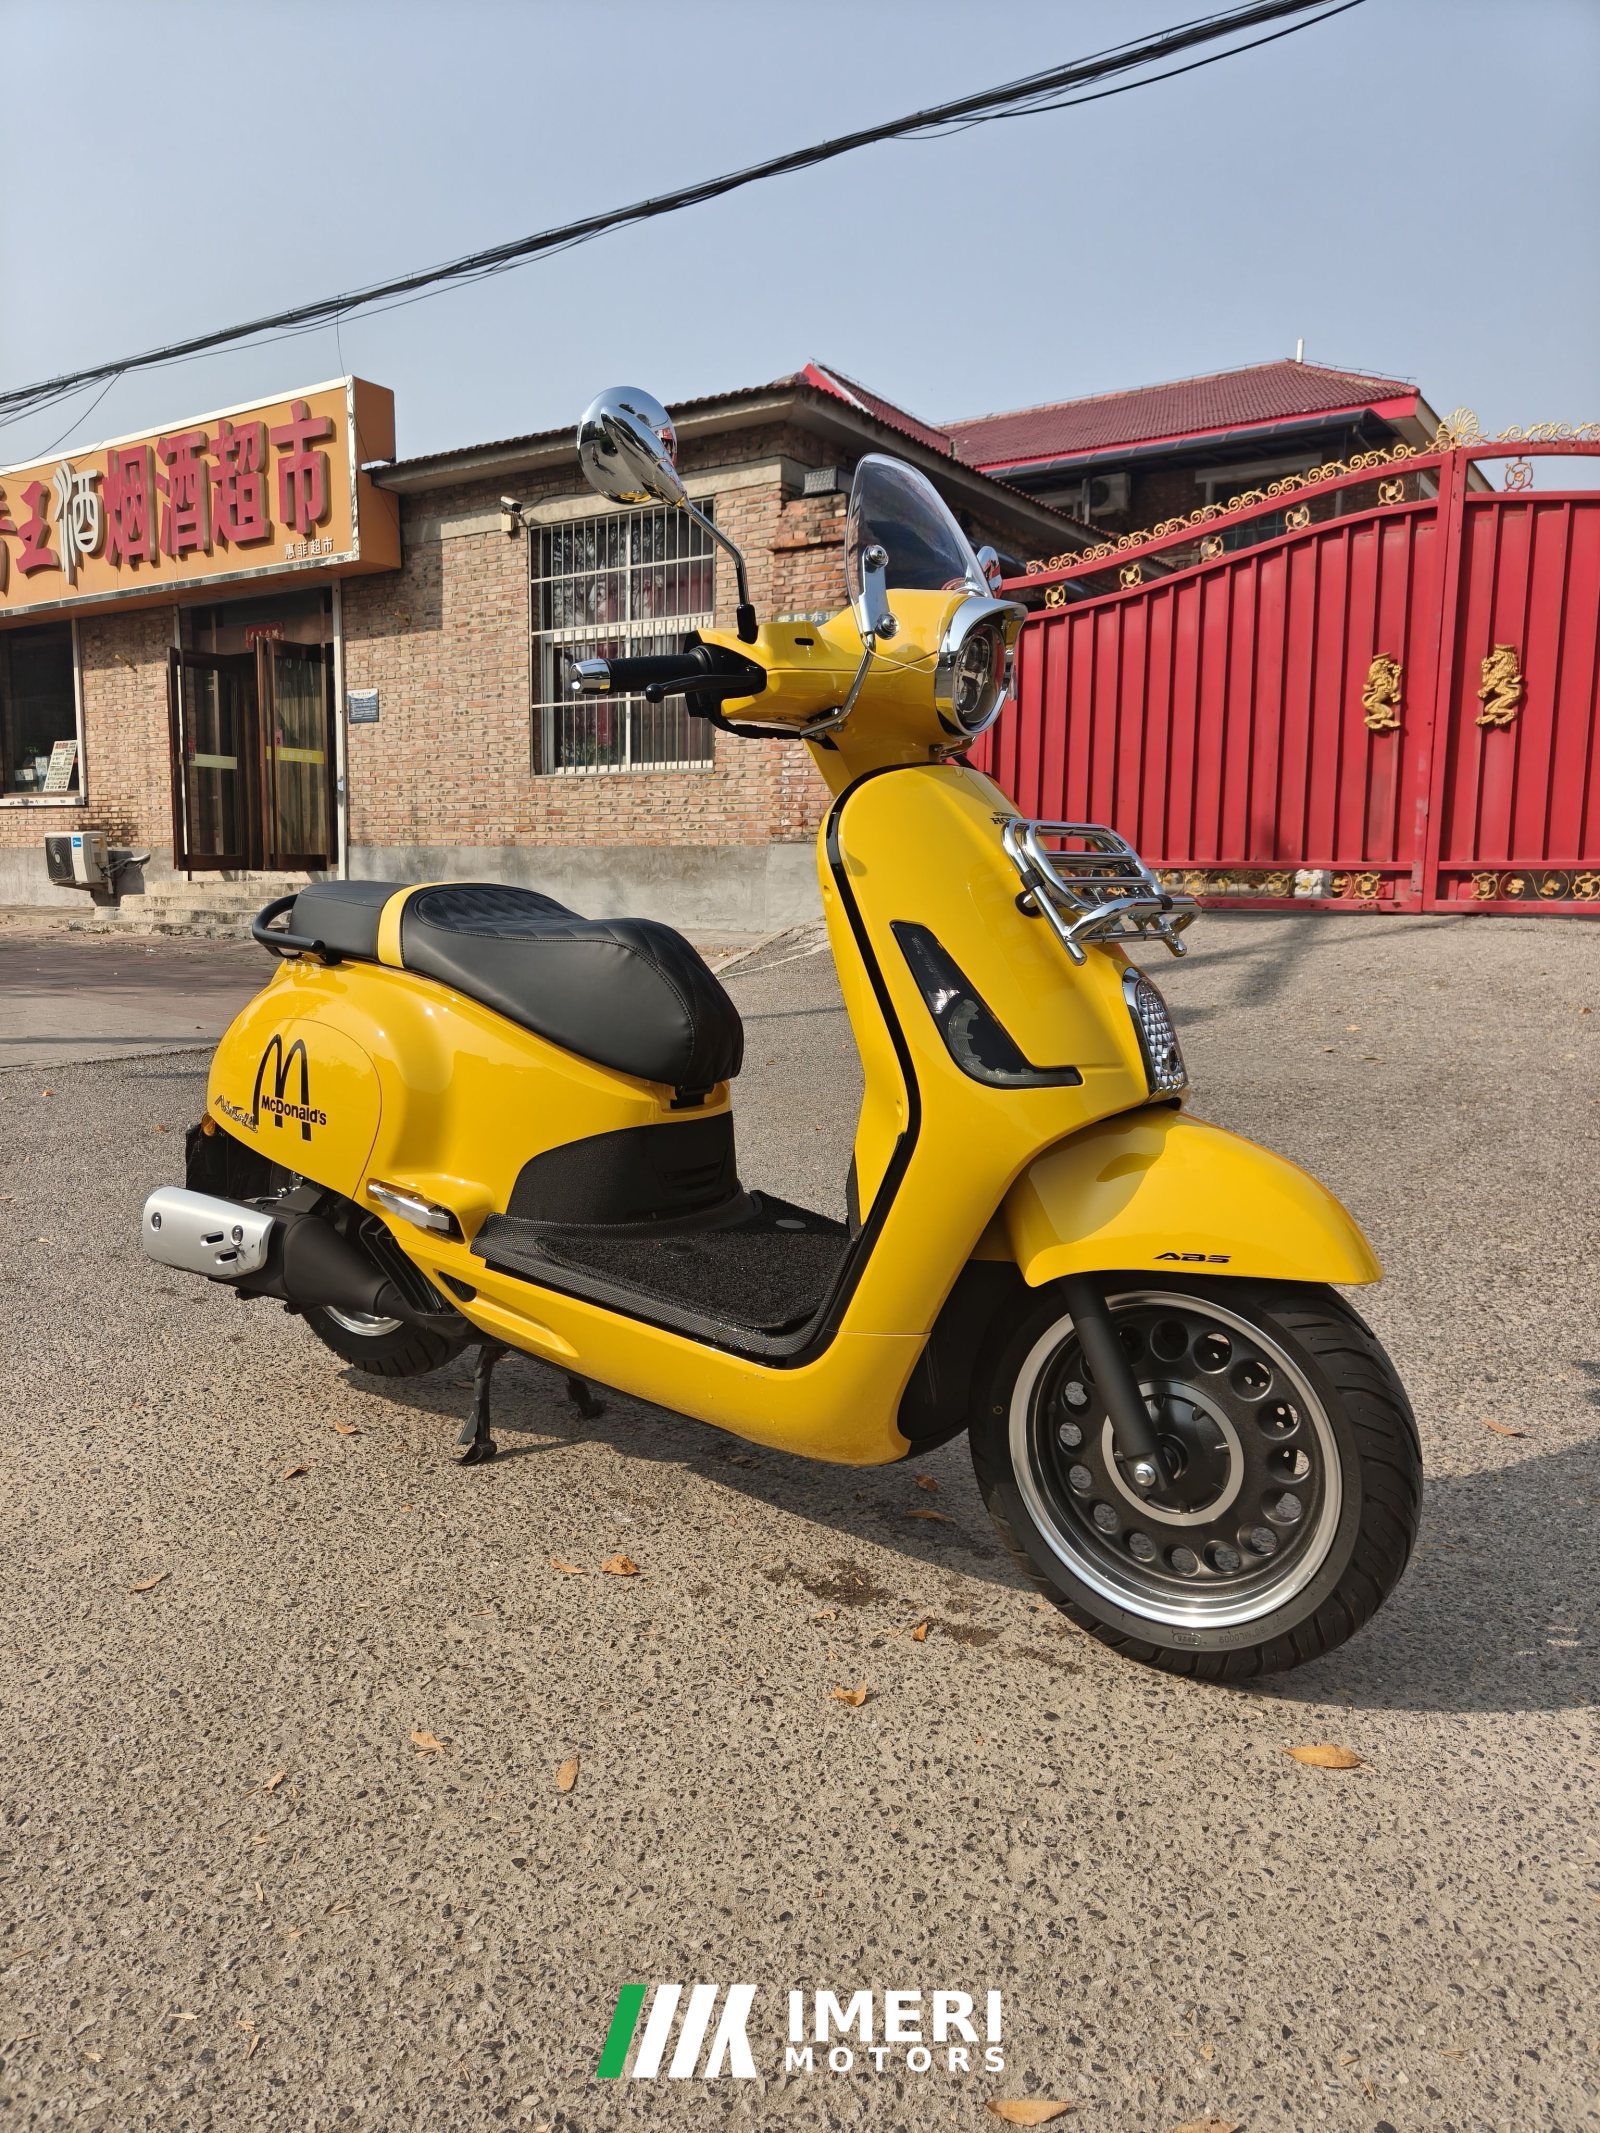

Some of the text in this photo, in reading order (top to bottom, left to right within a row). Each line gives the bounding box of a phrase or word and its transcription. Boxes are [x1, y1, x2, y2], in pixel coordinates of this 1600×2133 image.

[284, 536, 333, 559] 惠菲超市
[261, 1095, 327, 1125] McDonald's
[1153, 1252, 1231, 1264] ABS
